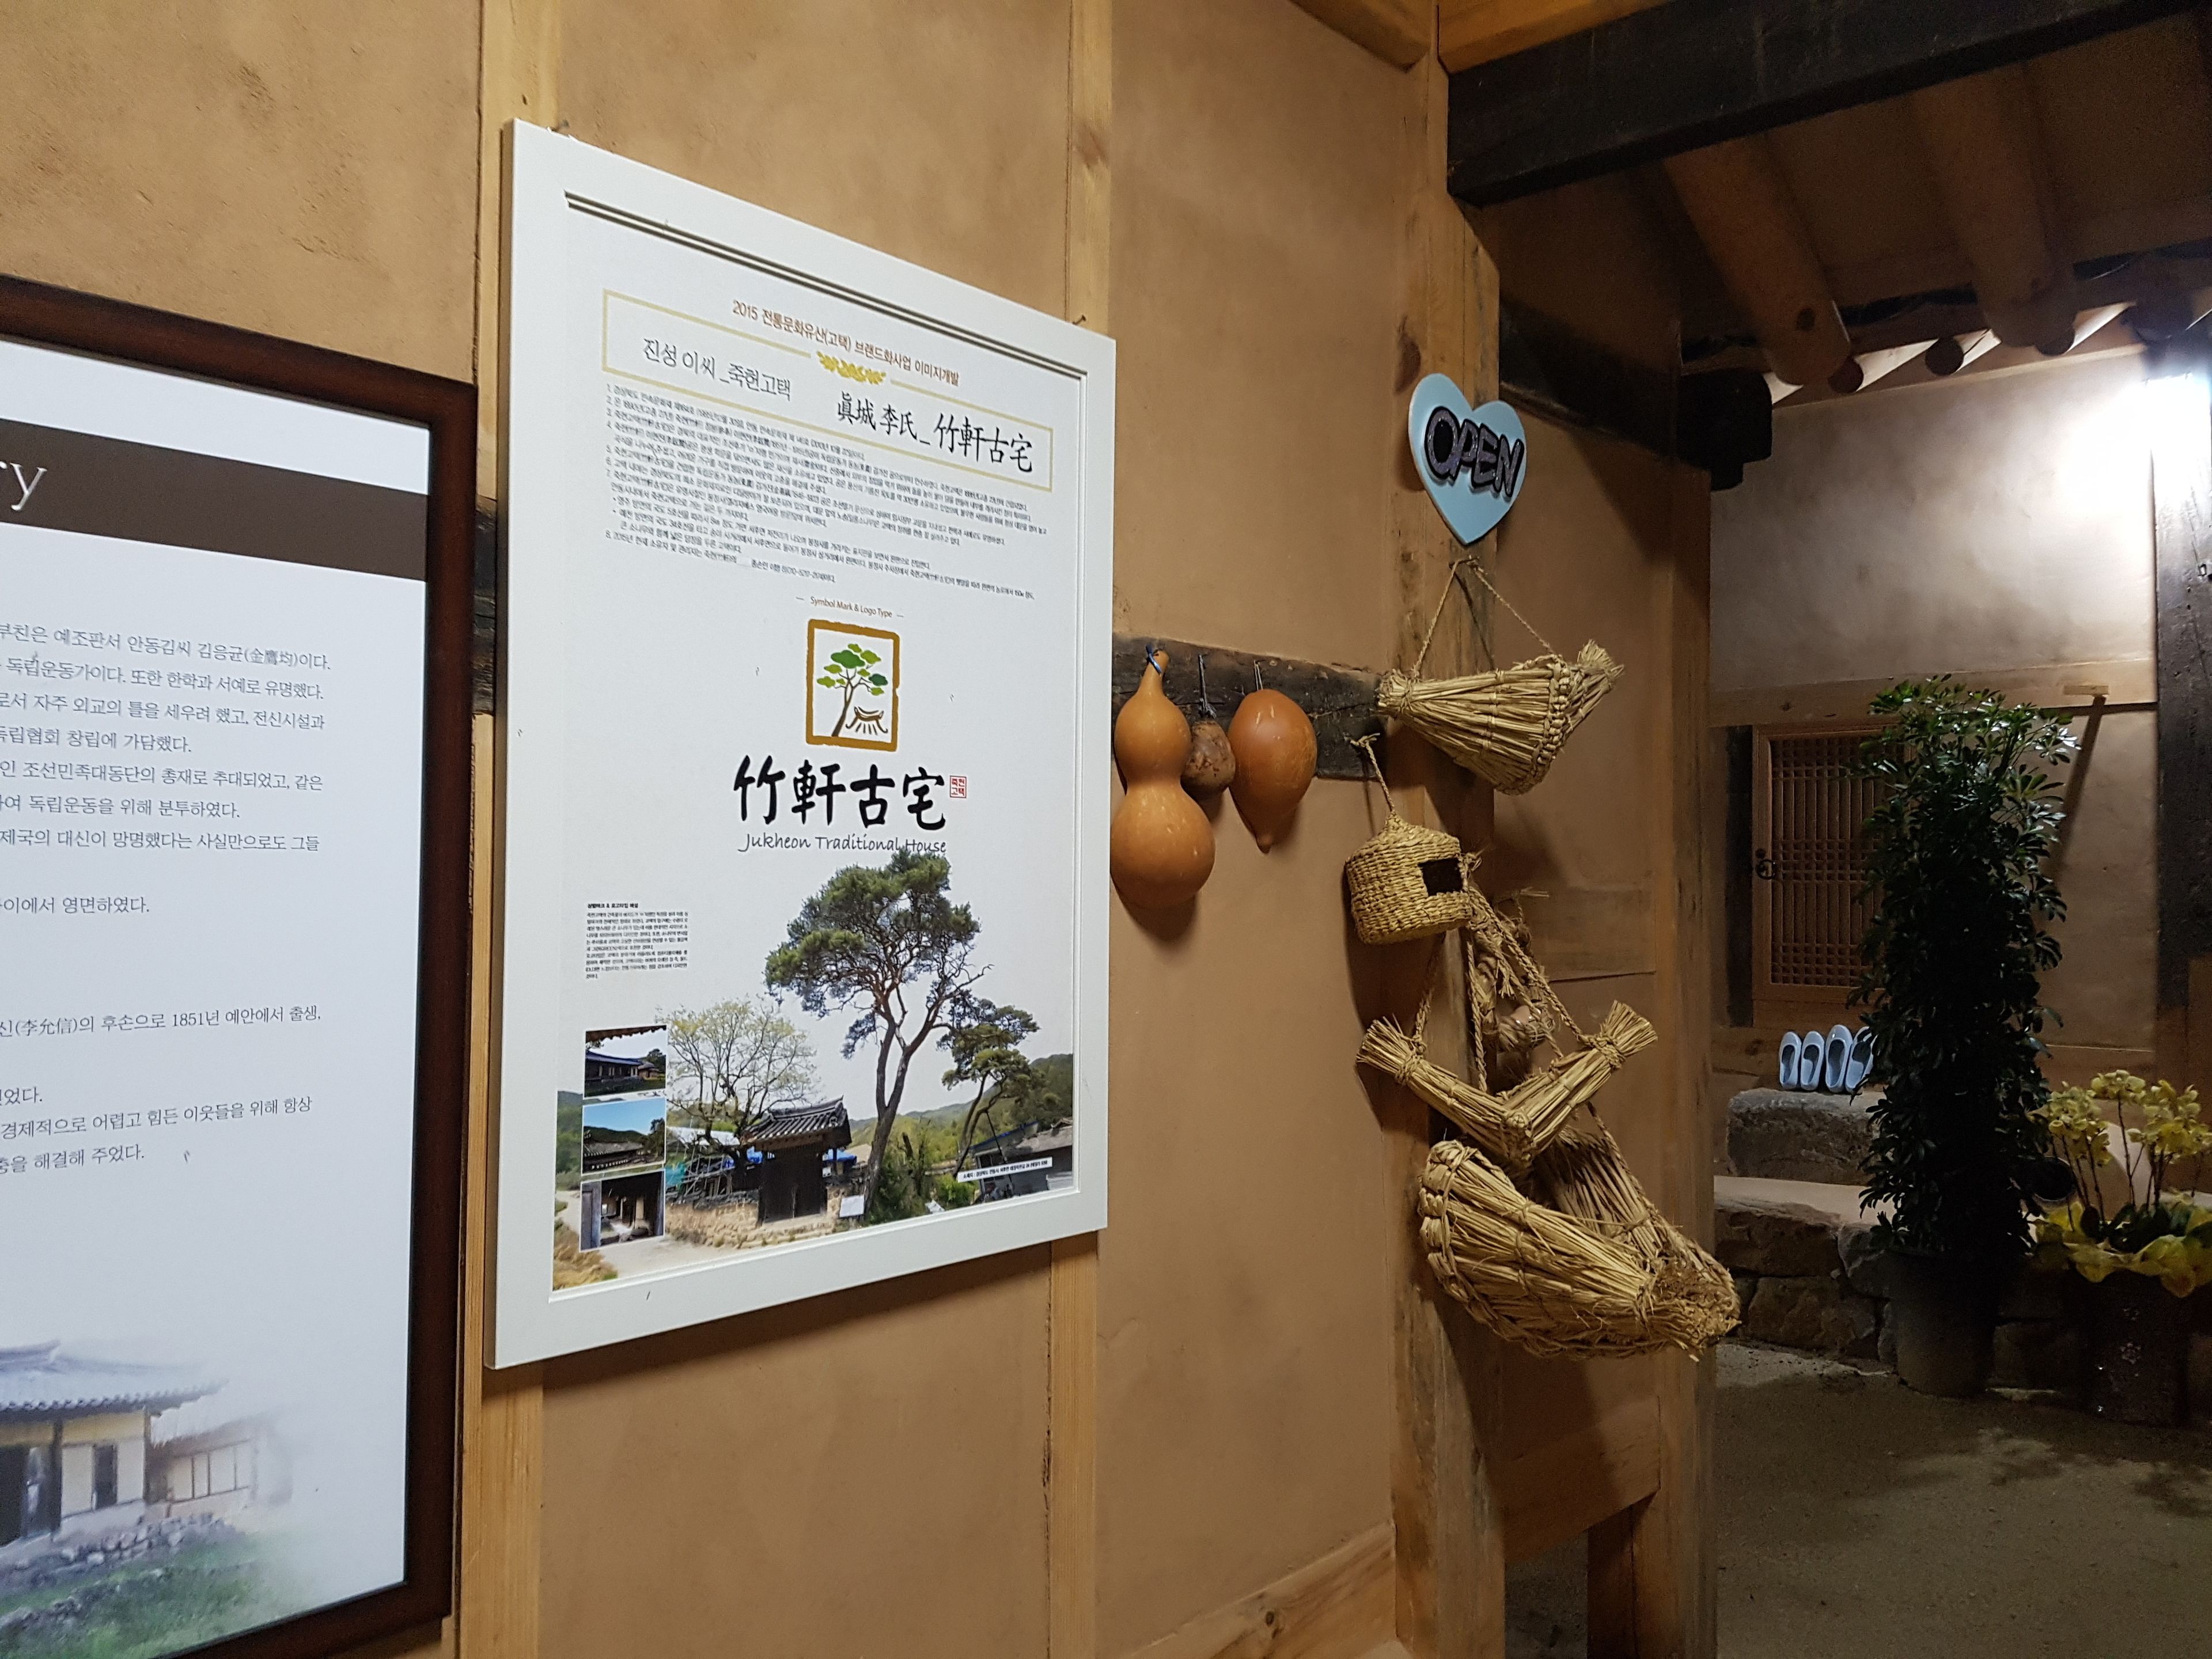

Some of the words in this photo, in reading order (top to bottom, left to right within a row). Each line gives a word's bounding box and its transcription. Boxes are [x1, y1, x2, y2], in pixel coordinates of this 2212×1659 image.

[733, 300, 758, 320] 2015
[762, 309, 851, 352] 전통문화유산(고택)
[854, 340, 911, 371] 브랜드화사업
[915, 360, 959, 387] 이미지개발
[644, 338, 677, 367] 진성
[682, 351, 715, 379] 이씨
[1424, 406, 1525, 498] OPEN
[810, 596, 835, 608] Symbol
[837, 601, 853, 611] Mark
[861, 605, 876, 616] Logo
[877, 608, 892, 618] Type
[54, 629, 120, 649] 예조판서
[128, 637, 190, 657] 안동김씨
[6, 657, 126, 683] 독립운동가이다.
[131, 671, 162, 686] 또한
[167, 672, 213, 690] 한학과
[217, 677, 261, 694] 서예로
[265, 681, 323, 699] 유명했다.
[34, 695, 67, 711] 자주
[73, 698, 121, 715] 외교의
[128, 702, 160, 719] 틀을
[165, 704, 209, 722] 세우려
[217, 709, 248, 724] 했고,
[253, 711, 325, 729] 전신시설과
[67, 730, 116, 748] 창립에
[124, 734, 191, 752] 가담했다.
[23, 762, 154, 783] 조선민족대동단의
[162, 768, 207, 785] 총재로
[213, 771, 289, 789] 추대되었고,
[296, 775, 323, 790] 같은
[733, 755, 946, 831] 竹軒古宅
[29, 796, 114, 814] 독립운동을
[120, 799, 151, 815] 위해
[159, 801, 240, 818] 분투하였다.
[58, 830, 105, 847] 대신이
[113, 831, 192, 849] 망명했다는
[197, 834, 286, 850] 사실만으로도
[291, 836, 319, 851] 그들
[738, 832, 811, 853] Jukheon
[815, 834, 900, 851] Traditional
[904, 839, 946, 853] House
[0, 897, 54, 914] 이에서
[63, 897, 149, 914] 영면하였다.
[101, 1014, 165, 1031] 후손으로
[173, 1010, 219, 1027] 1851년
[226, 1006, 283, 1024] 예안에서
[289, 1005, 320, 1021] 출생.
[0, 1086, 42, 1106] 었다.
[2, 1118, 86, 1139] 경제적으로
[93, 1113, 141, 1130] 어렵고
[147, 1108, 178, 1126] 힘든
[184, 1103, 244, 1122] 이웃들을
[250, 1099, 277, 1116] 위해
[284, 1096, 312, 1113] 항상
[35, 1149, 84, 1169] 해결해
[92, 1144, 144, 1164] 주었다.
